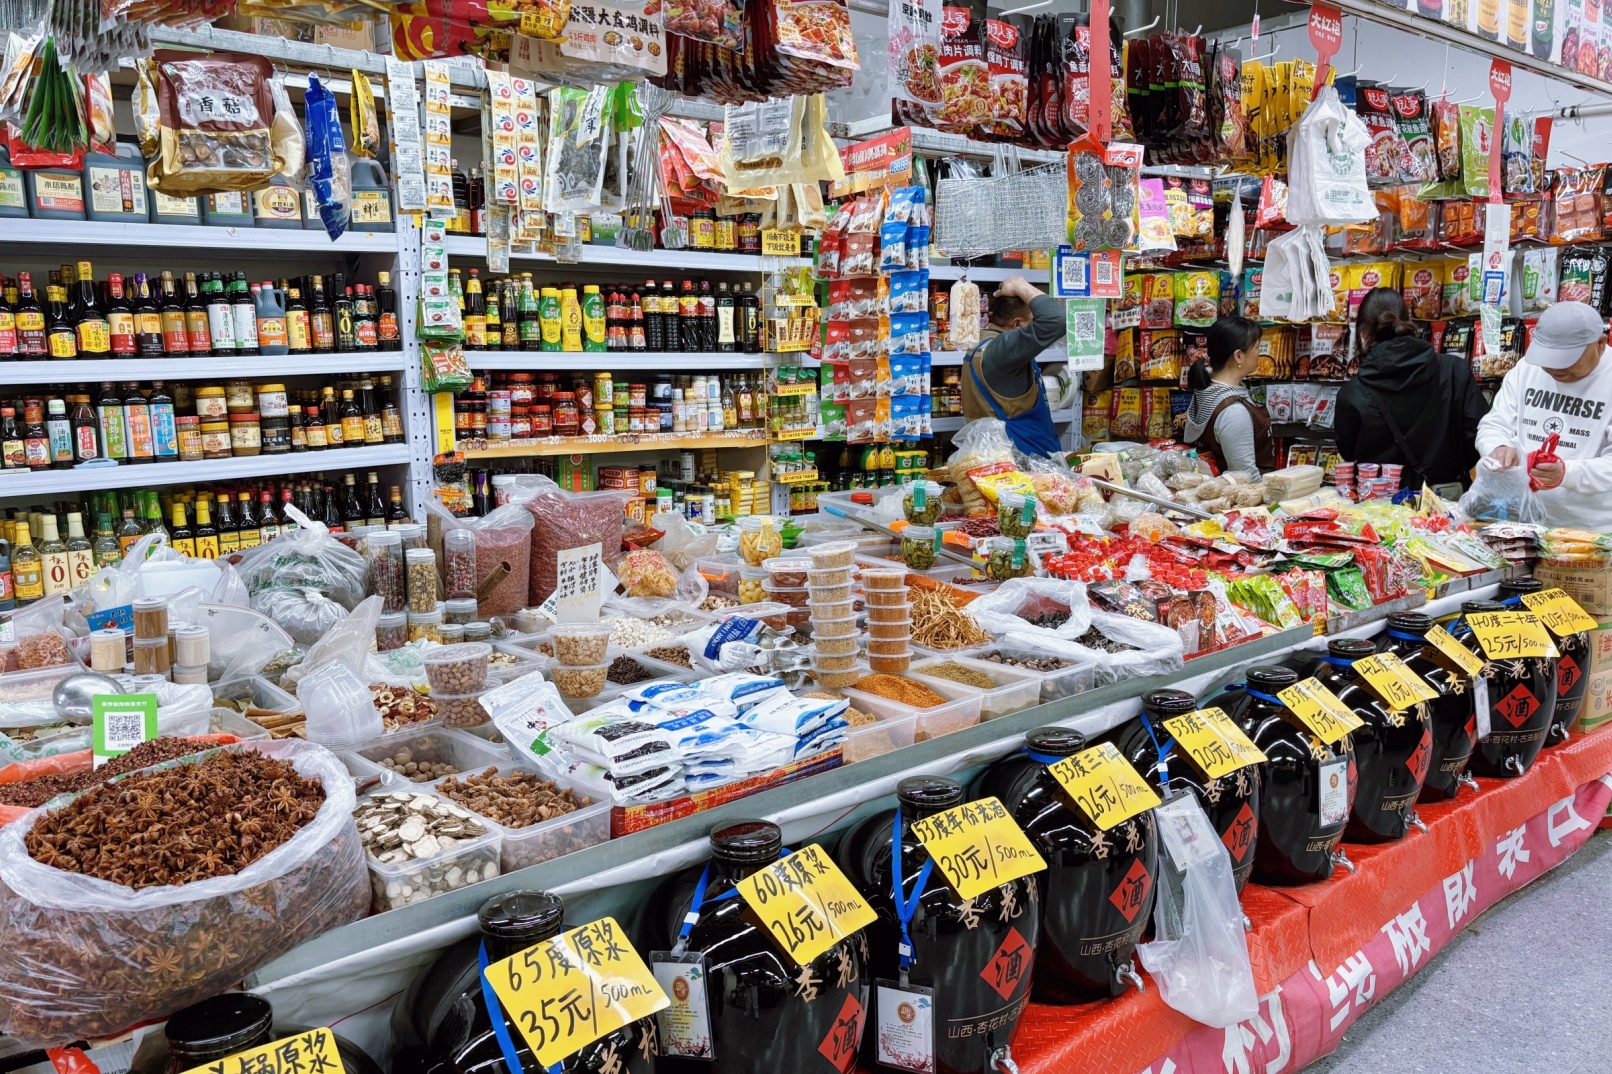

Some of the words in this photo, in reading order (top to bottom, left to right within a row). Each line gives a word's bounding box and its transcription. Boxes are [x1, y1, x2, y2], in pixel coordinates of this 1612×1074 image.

[987, 22, 1016, 41] 好人家
[1311, 12, 1341, 38] 大红袍
[939, 45, 982, 58] 肉片调料
[1490, 67, 1511, 87] 大红袍
[195, 96, 242, 115] 香菇
[1367, 92, 1388, 105] 好人家
[1396, 98, 1419, 112] 好人家
[766, 233, 796, 242] 川南下饭菜
[766, 243, 797, 252] 下饭就是香
[340, 317, 352, 334] 0
[1524, 387, 1606, 421] CONVERSE
[57, 428, 67, 449] 油醋汁
[109, 415, 119, 444] 白灼汁
[1568, 427, 1591, 438] MASS
[48, 555, 65, 566] 千禾
[73, 551, 90, 562] 千禾
[51, 565, 65, 583] 0
[711, 620, 734, 647] CURING
[1472, 612, 1540, 630] 40度二十年
[1483, 633, 1554, 655] 25元/500mL
[1478, 658, 1551, 680] 杏花村
[1445, 670, 1467, 696] 杏
[1505, 694, 1532, 719] 酒
[1053, 743, 1125, 786] 53度三十年
[1078, 775, 1149, 823] 26元/500mL
[914, 800, 1007, 844] 53度年份老酒
[1231, 817, 1252, 852] 酒
[939, 834, 1035, 889] 30元/500mL
[753, 848, 832, 907] 60度原浆
[1122, 873, 1147, 913] 酒
[770, 887, 864, 955] 26元/500mL
[507, 923, 629, 994] 65度原浆
[995, 943, 1026, 989] 酒
[518, 975, 654, 1054] 35元/500mL
[829, 1006, 863, 1063] 酒
